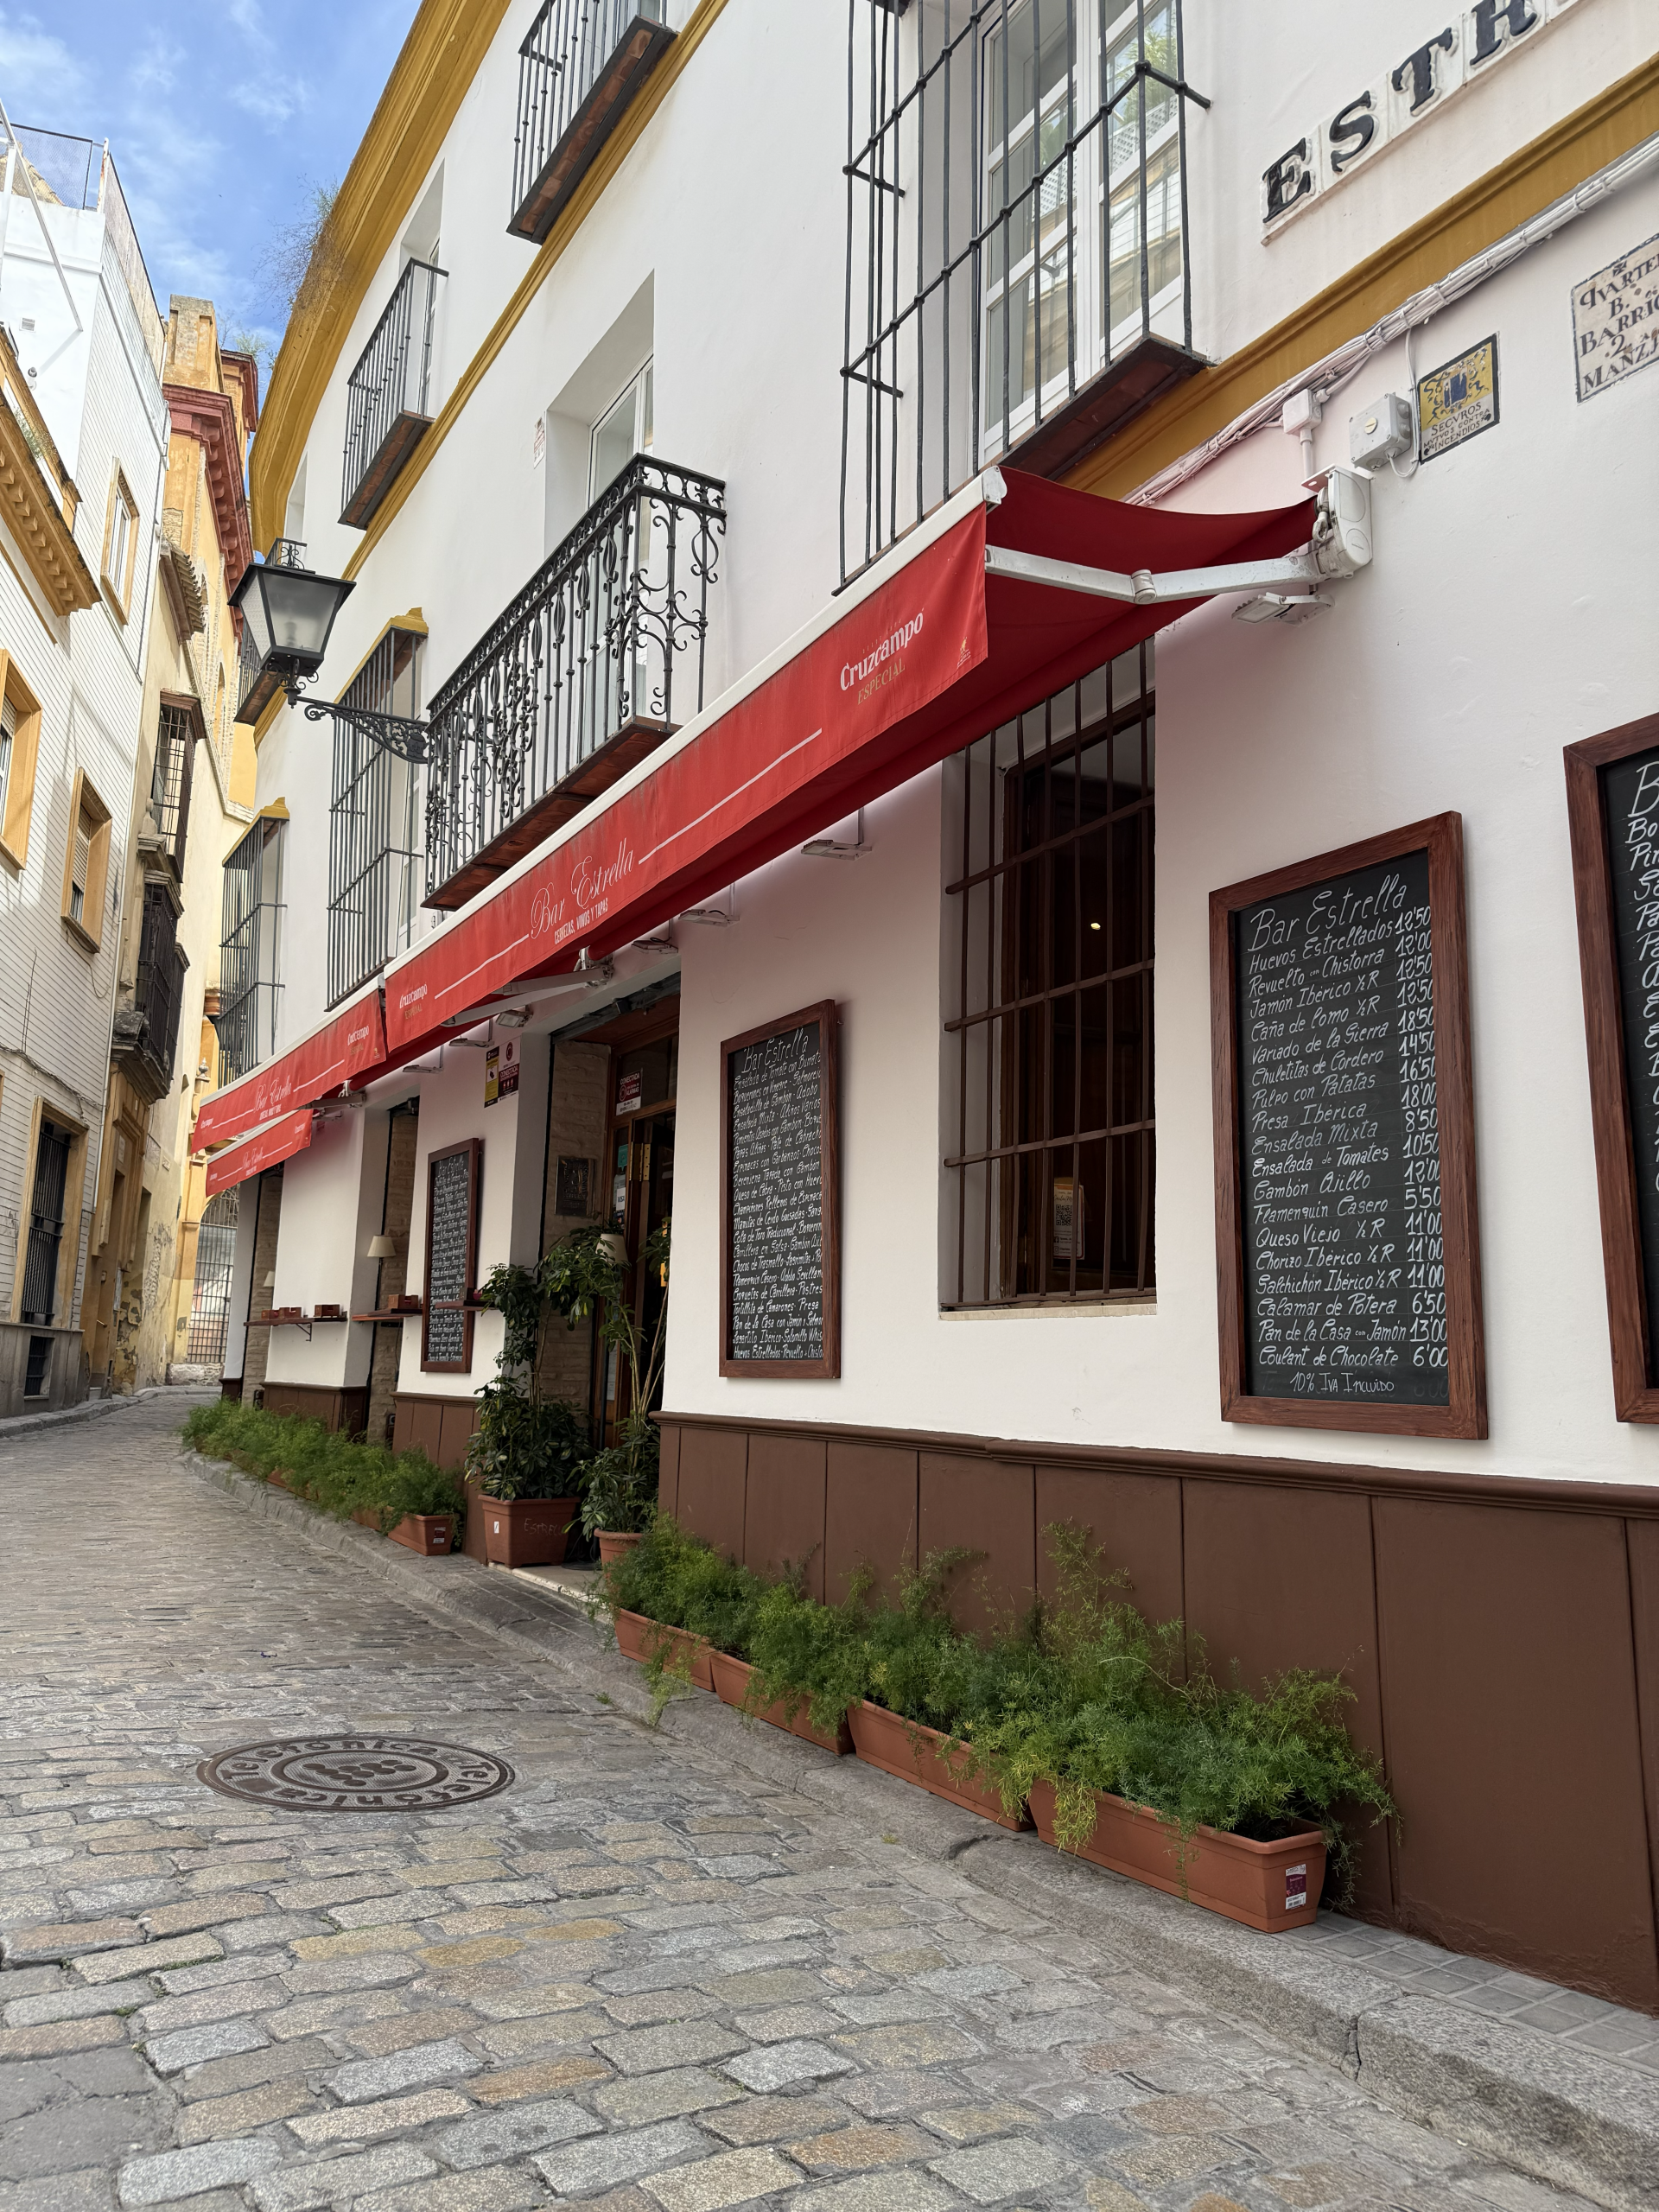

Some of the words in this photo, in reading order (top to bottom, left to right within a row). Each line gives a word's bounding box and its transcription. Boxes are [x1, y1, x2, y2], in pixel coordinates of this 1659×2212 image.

[1459, 409, 1490, 428] CONTRA
[1434, 421, 1479, 451] INCENDIOS
[840, 612, 924, 691] Cruzcampo
[857, 658, 906, 705] ESPECIAL
[531, 882, 565, 939] Bar
[571, 837, 634, 909] Estrella
[576, 909, 590, 930] VINOS
[591, 906, 594, 921] Y
[595, 898, 608, 919] TAPAS
[1248, 909, 1300, 951] Bar
[1306, 874, 1407, 934] Estrella
[1249, 950, 1296, 975] Huevos
[1303, 918, 1393, 959] Estrellados
[1249, 968, 1305, 998] Revuelto
[1322, 949, 1384, 978] Chistorra
[1250, 995, 1293, 1019] Jamón
[1297, 982, 1351, 1007] Ibérico
[1251, 1020, 1284, 1042] Caña
[1289, 1013, 1306, 1033] de
[741, 1046, 763, 1073] Bar
[765, 1027, 808, 1065] Estrella
[1253, 1039, 1299, 1065] Variado
[1306, 1034, 1321, 1052] de
[1326, 1027, 1340, 1048] la
[1344, 1022, 1389, 1044] Sierra
[761, 1067, 767, 1082] de
[1252, 1060, 1308, 1086] Chuletitas
[1313, 1053, 1325, 1074] de
[1331, 1046, 1383, 1071] Cordero
[1252, 1089, 1287, 1109] Pulpo
[1294, 1086, 1315, 1103] con
[1321, 1071, 1376, 1096] Patatas
[1252, 1111, 1288, 1133] Presa
[1300, 1101, 1367, 1125] Ibérica
[1252, 1127, 1322, 1155] Ensalada
[1328, 1120, 1378, 1144] Mixta
[784, 1167, 793, 1177] con
[1252, 1151, 1313, 1177] Ensalada
[1322, 1151, 1332, 1164] de
[1337, 1142, 1389, 1167] Tomates
[734, 1189, 749, 1201] Queso
[751, 1185, 757, 1198] de
[778, 1178, 791, 1192] Pisto
[794, 1179, 803, 1189] con
[1255, 1178, 1309, 1200] Gambón
[1337, 1196, 1389, 1216] Casero
[1256, 1227, 1299, 1247] Queso
[1303, 1224, 1340, 1243] Viejo
[1256, 1251, 1302, 1270] Chorizo
[1304, 1247, 1361, 1268] Ibérico
[733, 1287, 759, 1300] Croquetas
[761, 1285, 767, 1299] de
[798, 1281, 823, 1294] Postres
[1256, 1272, 1321, 1294] Salchichón
[1324, 1269, 1373, 1291] Ibérico
[758, 1300, 764, 1313] de
[766, 1300, 794, 1313] Camarones
[798, 1298, 818, 1311] Presa
[1257, 1297, 1322, 1316] Calamar
[1325, 1294, 1342, 1316] de
[1347, 1293, 1397, 1315] Potera
[733, 1315, 742, 1330] Pan
[745, 1315, 751, 1329] de
[762, 1315, 774, 1328] Casa
[777, 1319, 785, 1327] con
[1259, 1319, 1282, 1342] Pan
[1286, 1319, 1300, 1341] de
[1304, 1319, 1317, 1342] la
[1320, 1319, 1351, 1340] Casa
[1367, 1319, 1407, 1341] Jamón
[734, 1345, 750, 1359] Huevos
[752, 1344, 780, 1358] Estrellados
[1259, 1345, 1311, 1366] Coulant
[1313, 1346, 1326, 1366] de
[1330, 1345, 1399, 1367] Chocolate
[1290, 1371, 1315, 1393] 10%
